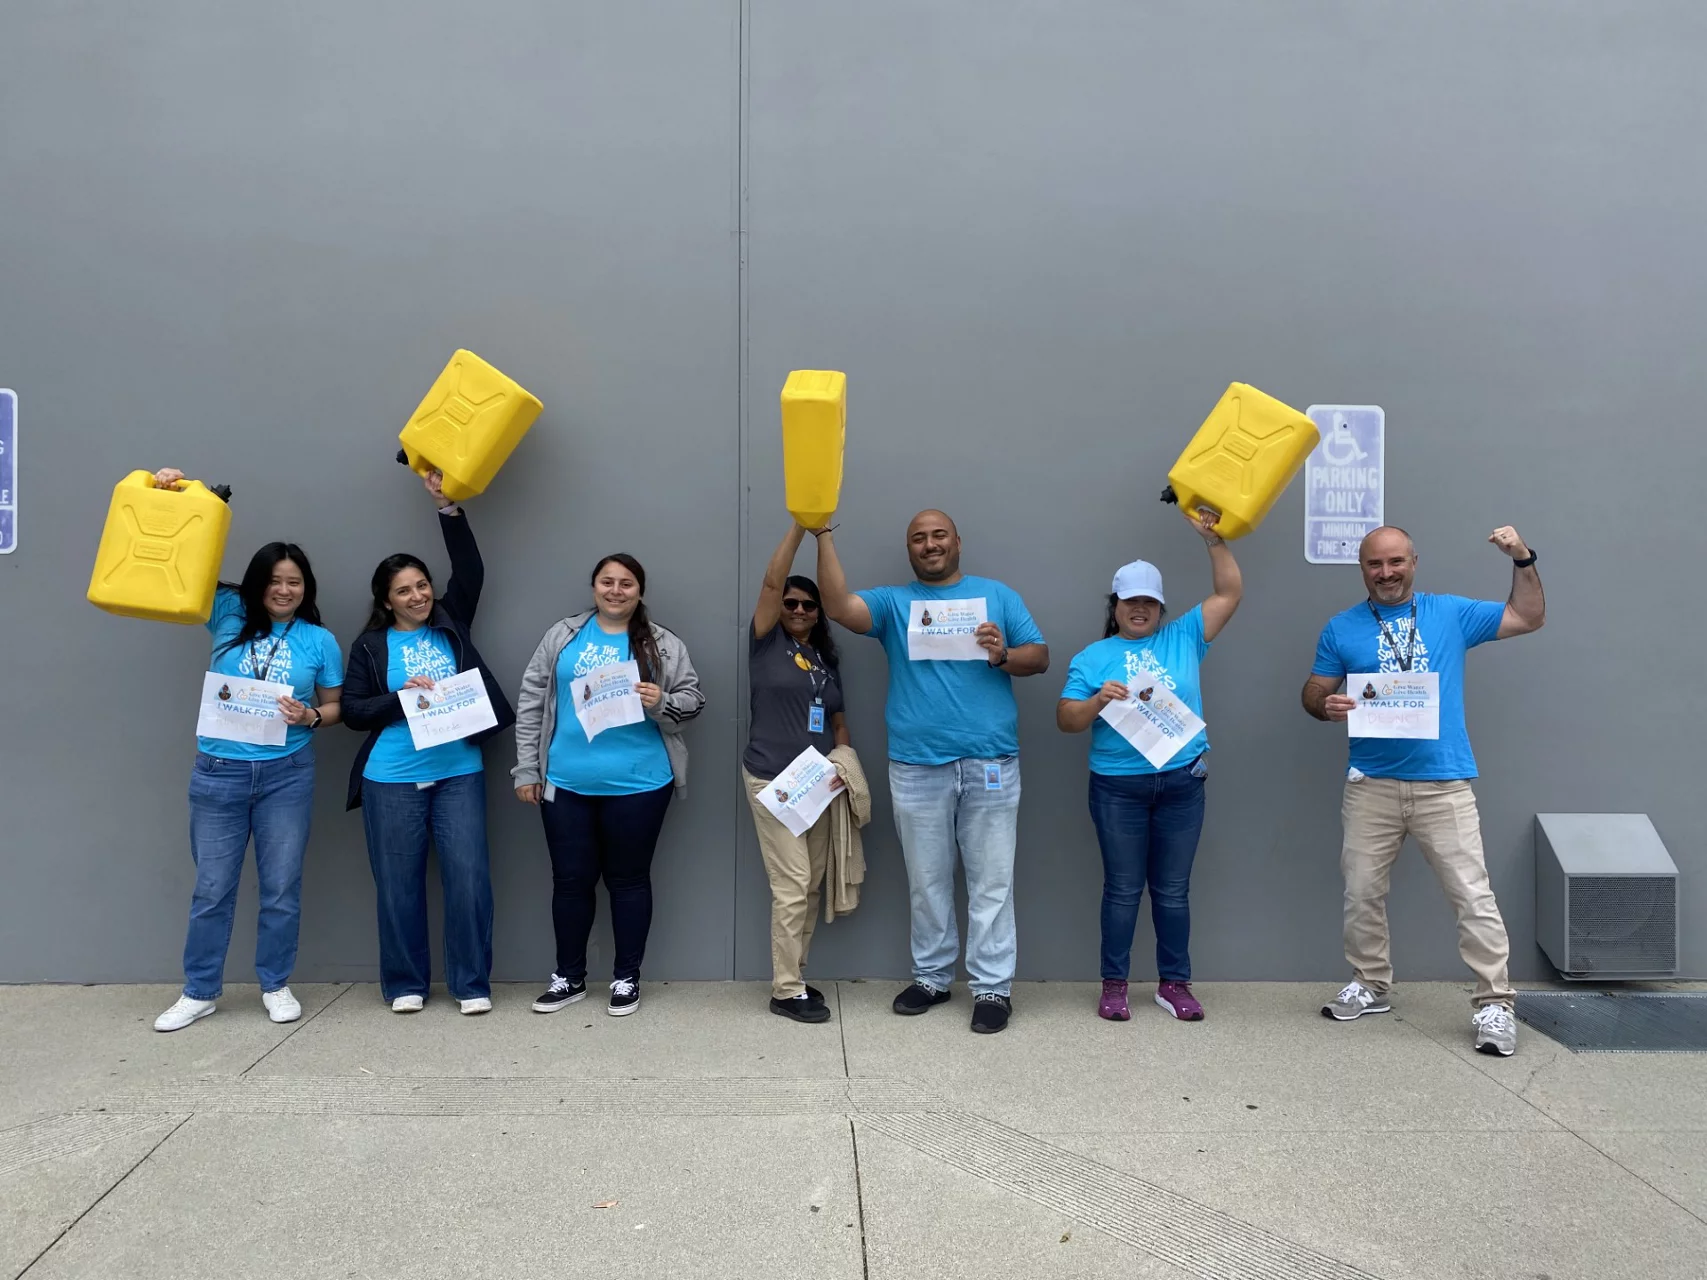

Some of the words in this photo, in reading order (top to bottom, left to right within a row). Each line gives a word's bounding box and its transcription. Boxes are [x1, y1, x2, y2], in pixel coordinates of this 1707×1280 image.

[1312, 467, 1378, 489] PARKING
[1325, 491, 1365, 513] ONLY
[1322, 523, 1366, 537] MINIMUM
[1317, 541, 1339, 555] FINE
[927, 627, 954, 635] WALK
[957, 627, 976, 635] FOR
[585, 642, 599, 653] BE
[602, 645, 620, 657] THE
[405, 655, 452, 678] SOMEONE
[578, 651, 621, 668] REASON
[587, 694, 608, 708] WALK
[610, 688, 630, 698] FOR
[1370, 700, 1400, 708] WALK
[1403, 700, 1425, 708] FOR
[223, 703, 252, 715] WALK
[254, 709, 275, 718] FOR
[428, 705, 455, 717] WALK
[457, 698, 477, 709] FOR
[1136, 703, 1158, 725] WALK
[1157, 723, 1175, 740] FOR
[789, 786, 811, 805] WALK
[810, 770, 826, 787] FOR
